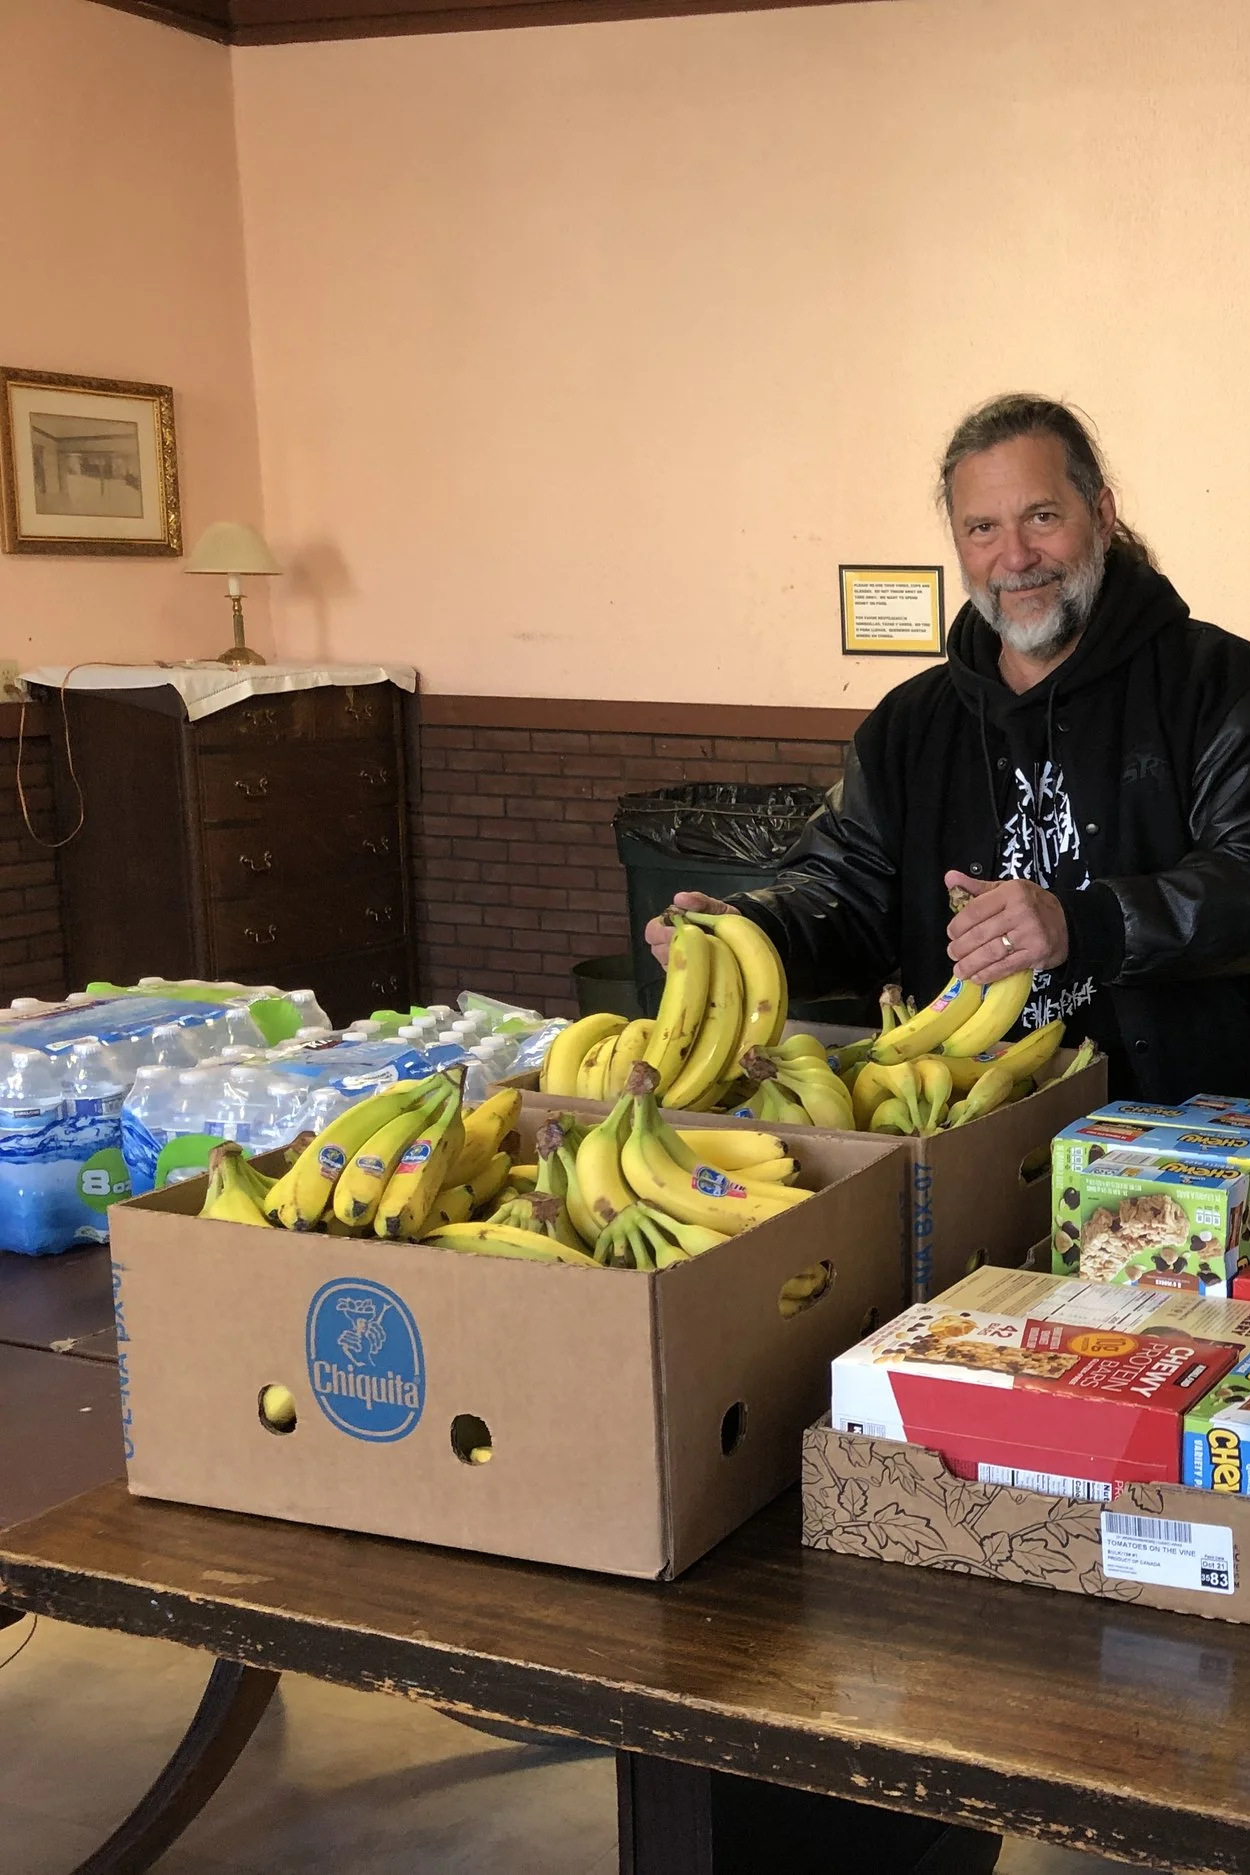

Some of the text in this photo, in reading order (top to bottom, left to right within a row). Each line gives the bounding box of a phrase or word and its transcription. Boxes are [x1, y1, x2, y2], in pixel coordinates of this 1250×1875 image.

[82, 1169, 111, 1196] 8
[1091, 1337, 1129, 1353] 10g
[1080, 1359, 1119, 1388] BARS
[1100, 1342, 1169, 1393] PROTEIN
[1130, 1346, 1195, 1399] CHEWY
[313, 1360, 420, 1411] Chiquita
[1193, 1439, 1204, 1478] VARIETY
[1106, 1539, 1197, 1557] TOMATOES ON THE VINE
[1107, 1555, 1132, 1563] PRODUCT
[1139, 1559, 1161, 1567] CANADA
[1202, 1561, 1225, 1570] Oct 21
